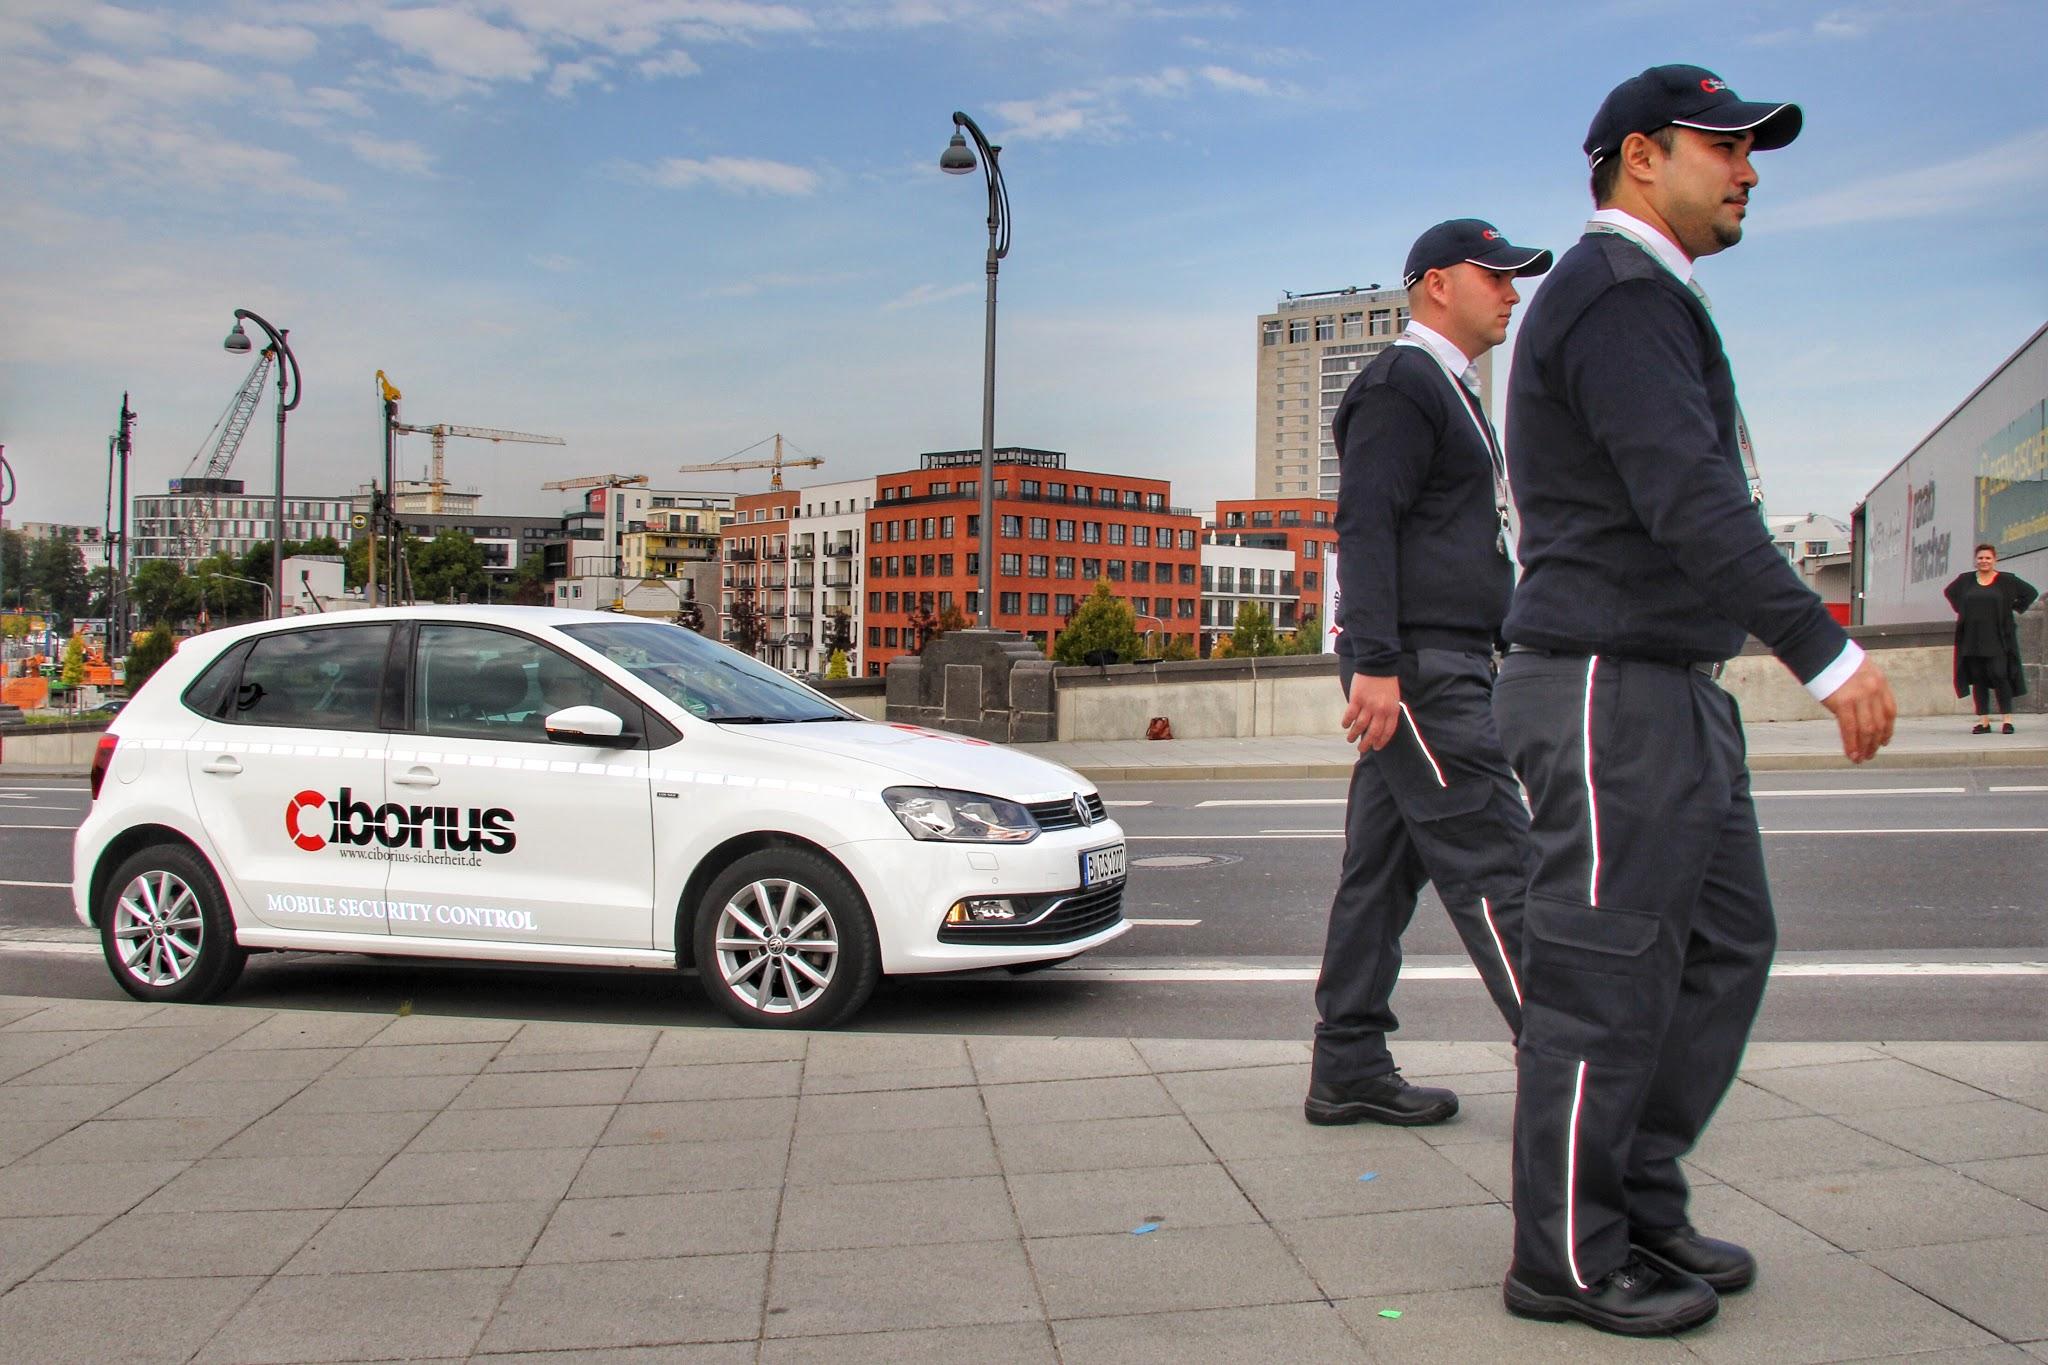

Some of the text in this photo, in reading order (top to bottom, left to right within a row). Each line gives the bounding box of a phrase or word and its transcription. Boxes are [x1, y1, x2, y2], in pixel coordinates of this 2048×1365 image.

[286, 787, 517, 855] Ciborius
[340, 846, 482, 867] www.ciborius-sicherheit.de
[267, 893, 538, 931] MOBILE SECURITY CONTROL
